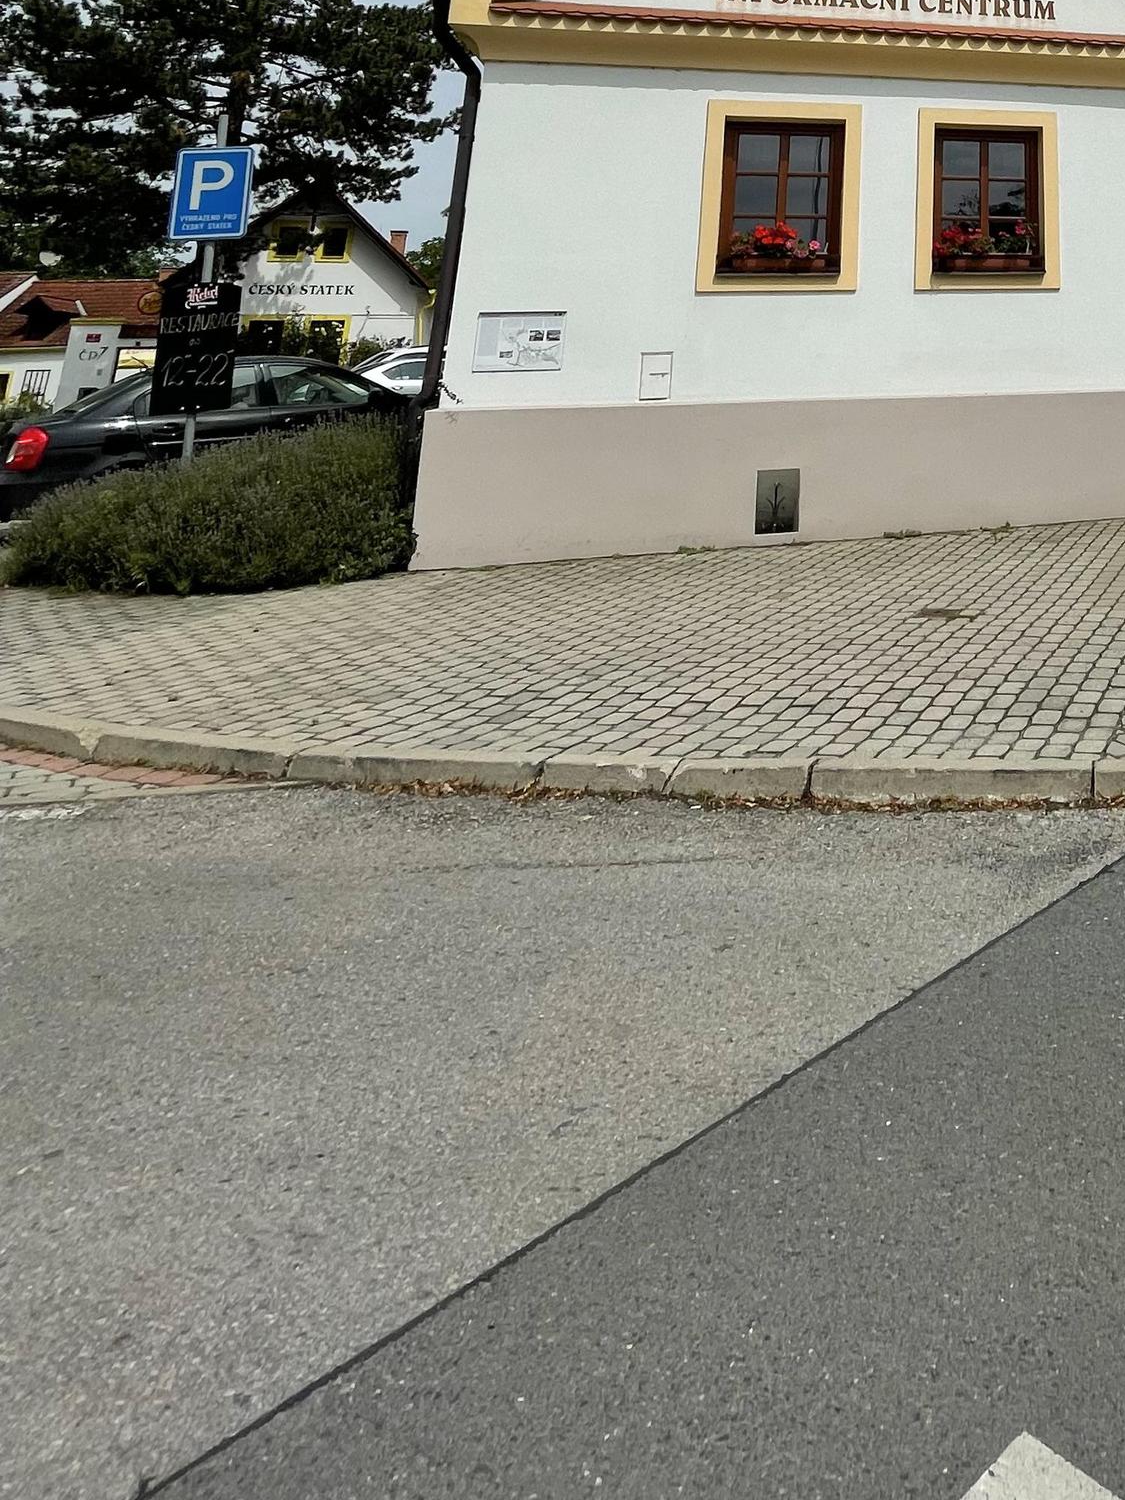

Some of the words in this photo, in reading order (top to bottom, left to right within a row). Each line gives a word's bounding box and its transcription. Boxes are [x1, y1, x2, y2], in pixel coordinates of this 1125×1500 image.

[189, 160, 235, 211] P
[249, 282, 297, 296] ČESKÝ
[299, 284, 355, 296] STATEK
[160, 311, 241, 334] RESTAURACE
